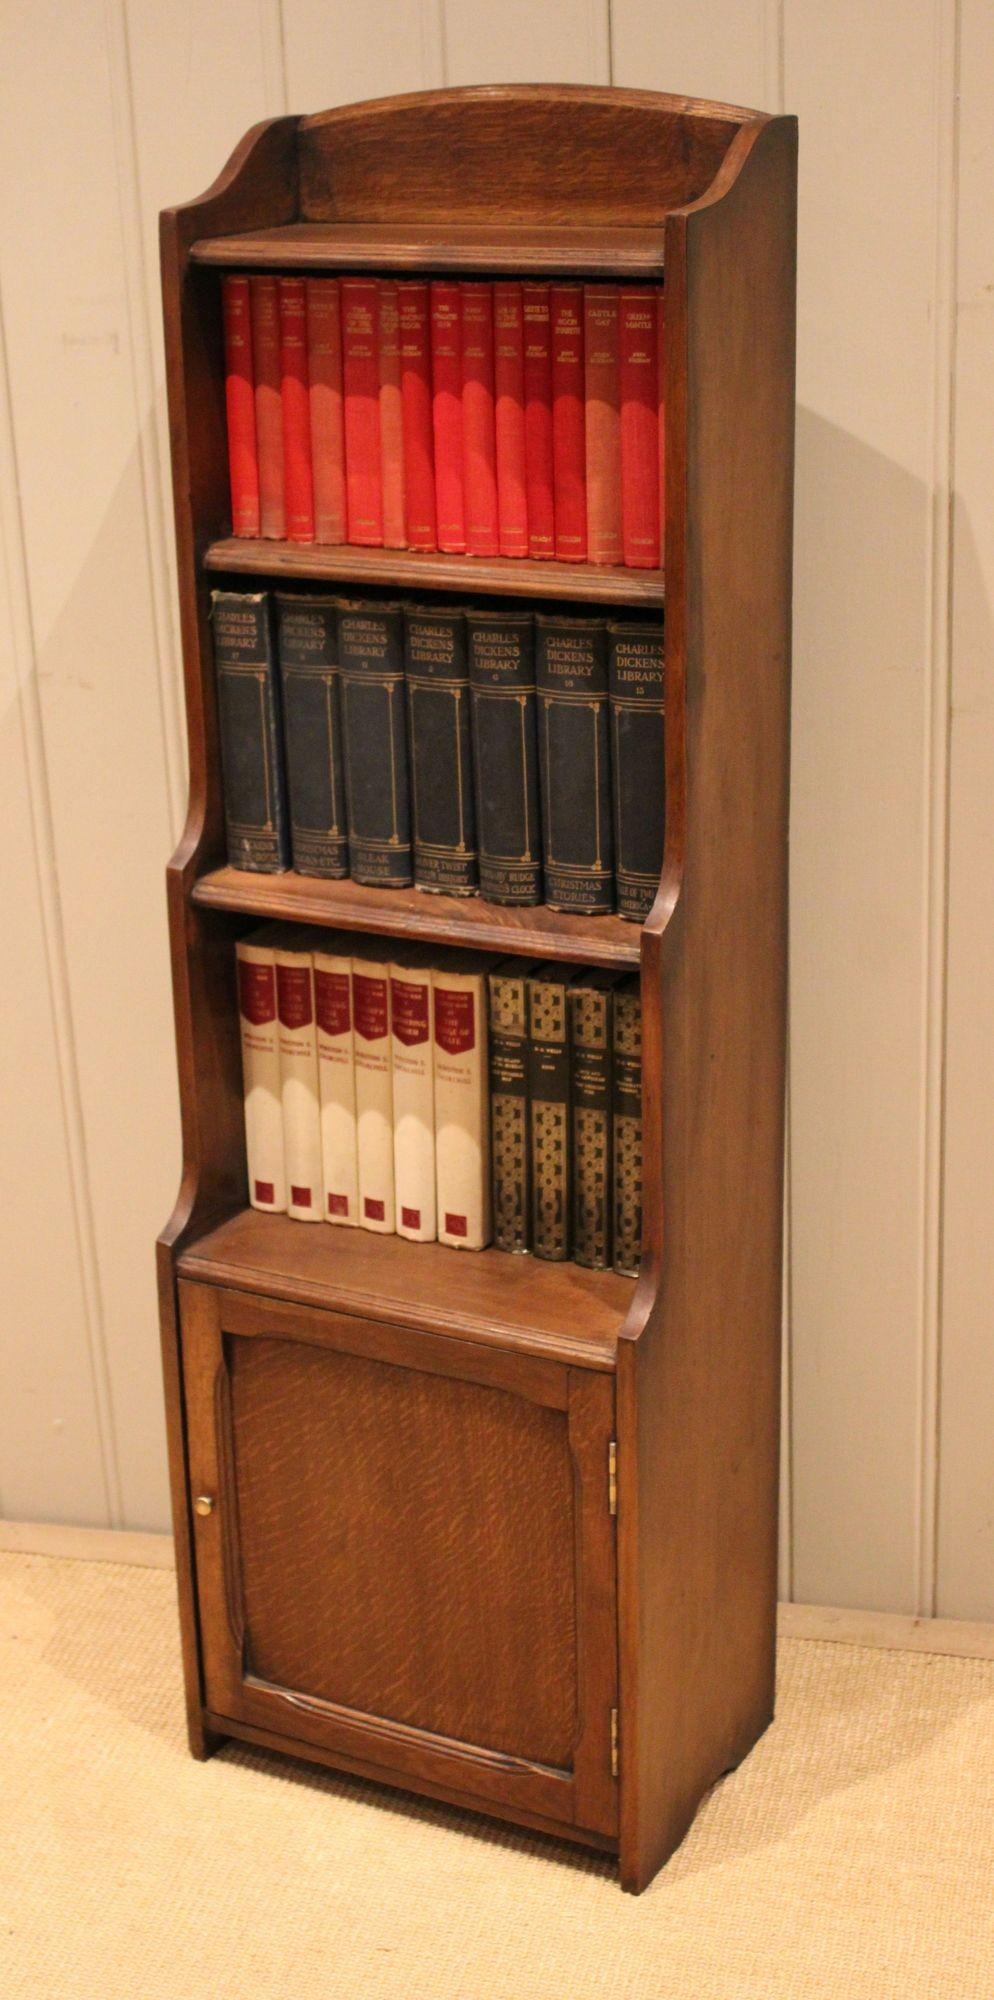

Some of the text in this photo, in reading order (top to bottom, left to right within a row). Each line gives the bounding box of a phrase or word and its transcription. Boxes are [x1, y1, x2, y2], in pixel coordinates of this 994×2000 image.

[409, 624, 453, 638] CHARLES
[410, 636, 454, 650] DICKENS
[472, 632, 520, 644] CHARLES
[546, 637, 592, 649] CHARLES
[474, 644, 520, 657] DICKENS
[547, 650, 594, 662] DICKENS
[615, 644, 664, 656] CHARLES
[411, 649, 454, 664] LIBRARY
[616, 656, 664, 669] DICKENS
[475, 658, 520, 670] LIBRARY
[548, 663, 594, 676] LIBRARY
[617, 670, 664, 682] LIBRARY
[548, 878, 602, 890] CHRISTMAS
[553, 890, 596, 903] STORIES
